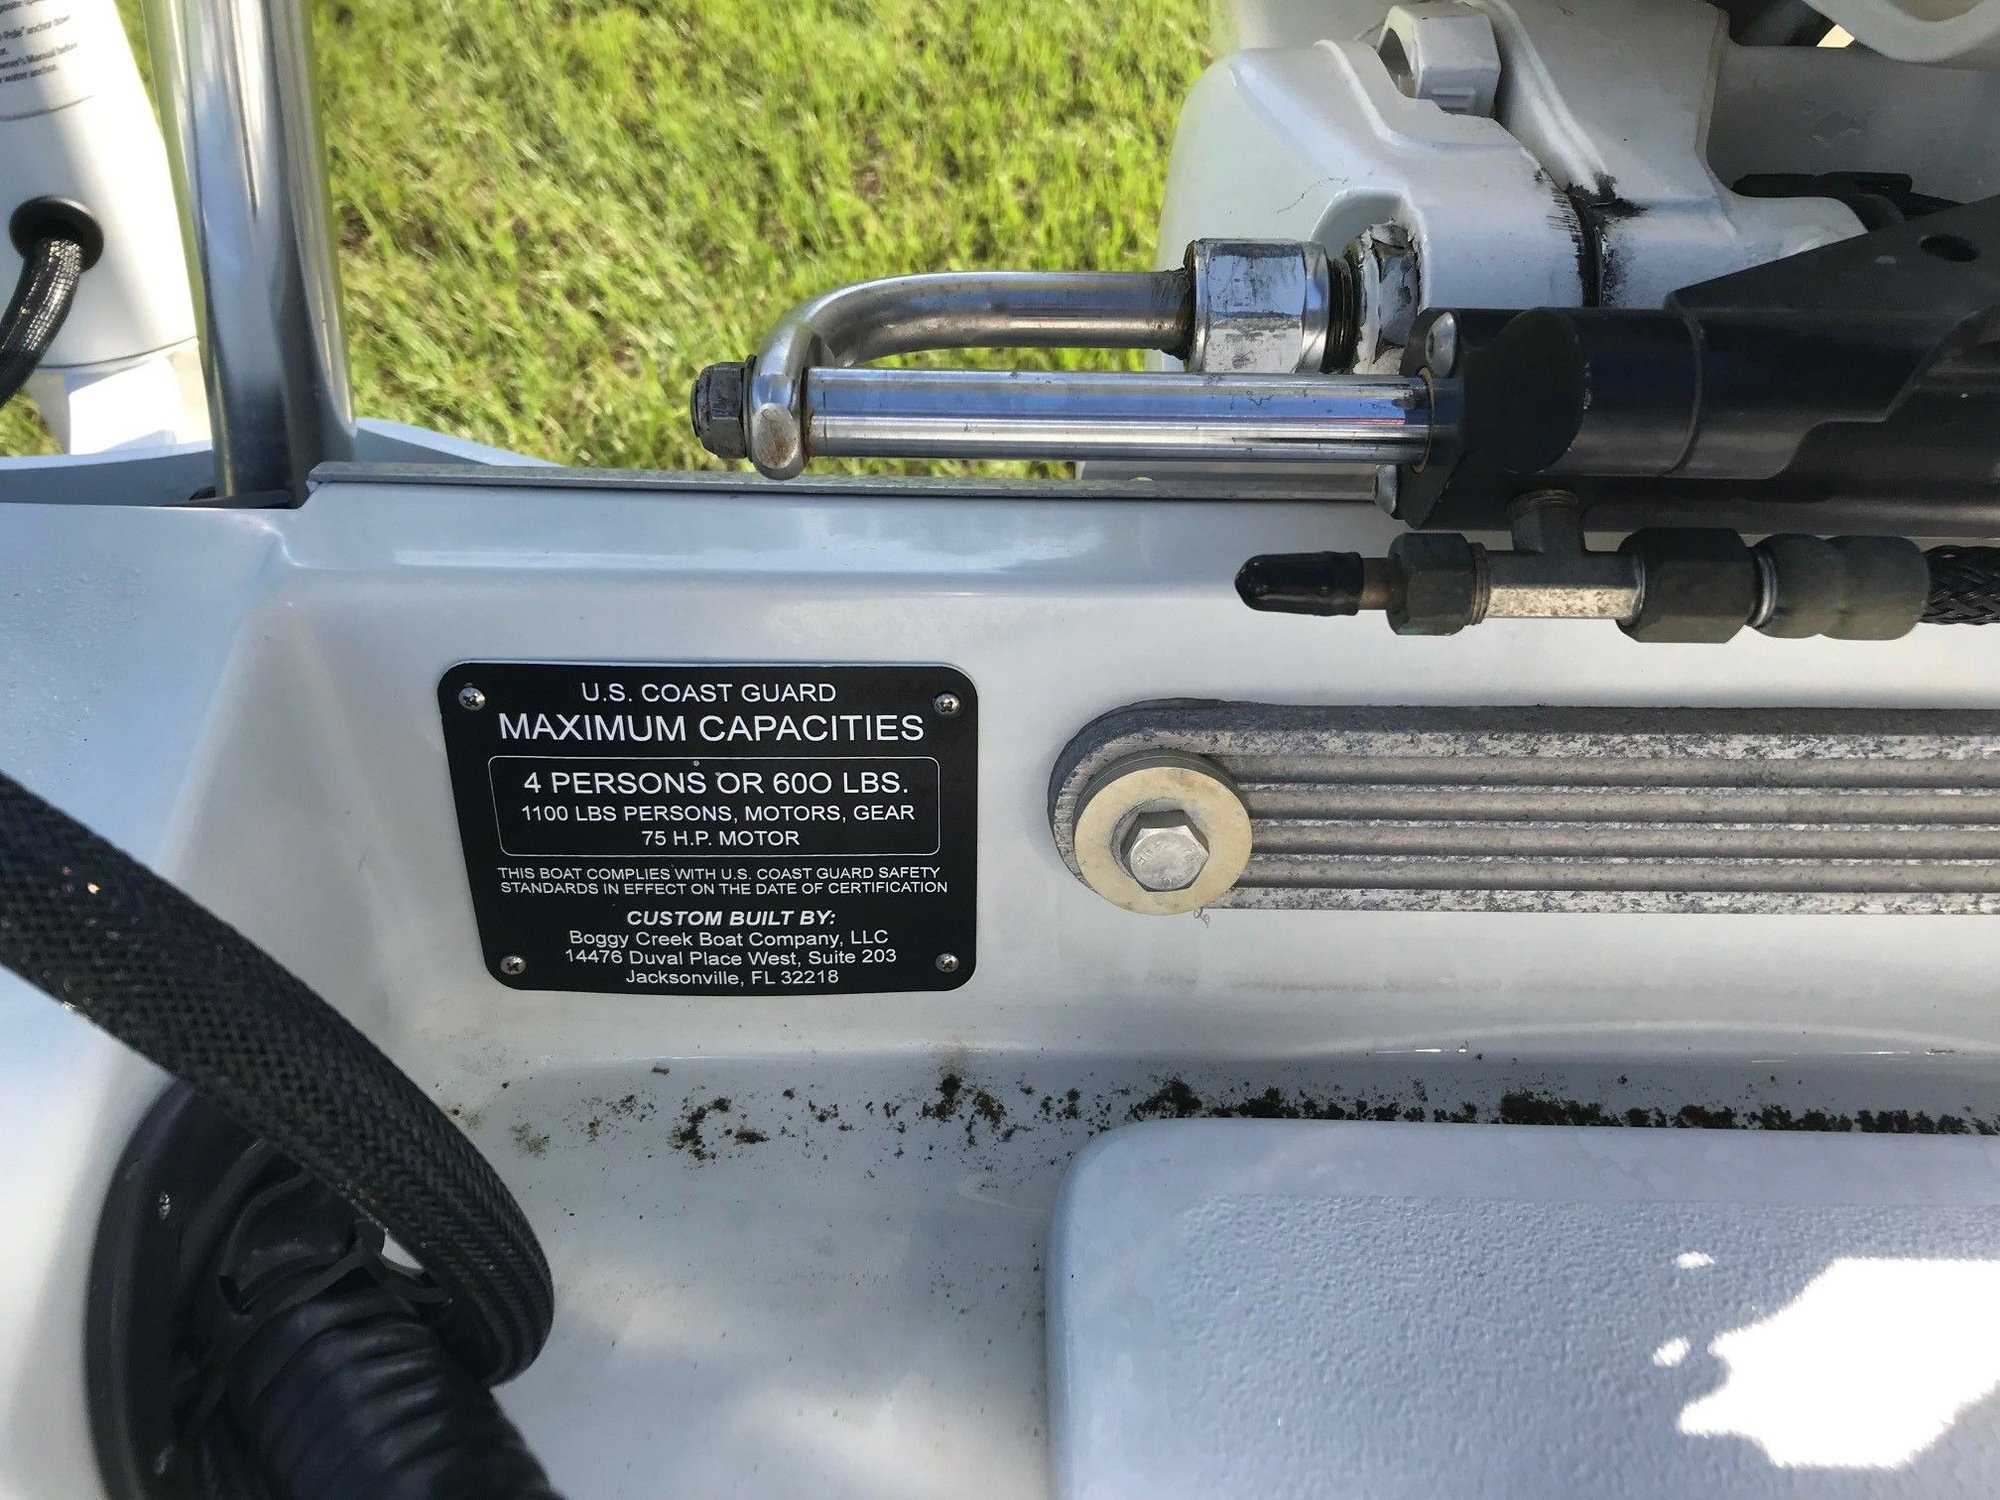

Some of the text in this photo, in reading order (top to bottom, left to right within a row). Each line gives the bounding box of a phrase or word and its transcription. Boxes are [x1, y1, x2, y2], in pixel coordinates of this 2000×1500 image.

[582, 683, 836, 702] U.S. COAST GUARD
[499, 713, 923, 741] MAXIMUM CAPACITIES
[524, 772, 541, 793] 4
[551, 772, 706, 794] PERSONS
[717, 772, 764, 794] OR
[843, 772, 907, 793] LBS.
[522, 805, 914, 823] 1100 LBS PERSONS, MOTORS, GEAR
[642, 831, 800, 845] 75 H.P. MOTOR
[496, 866, 941, 881] THIS BOAT COMPLIES WITH U.S. COAST GUARD SAFETY
[500, 881, 948, 895] STANDARDS IN EFFECT ON THE DATE OF CERTIFICATION
[627, 910, 835, 926] CUSTOM BUILT BY:
[570, 930, 888, 949] Boggy Creek Boat Company, LLC
[566, 949, 896, 967] 14476 Duval Place West, Suite 203
[626, 970, 838, 986] Jacksonville, FL 32218
